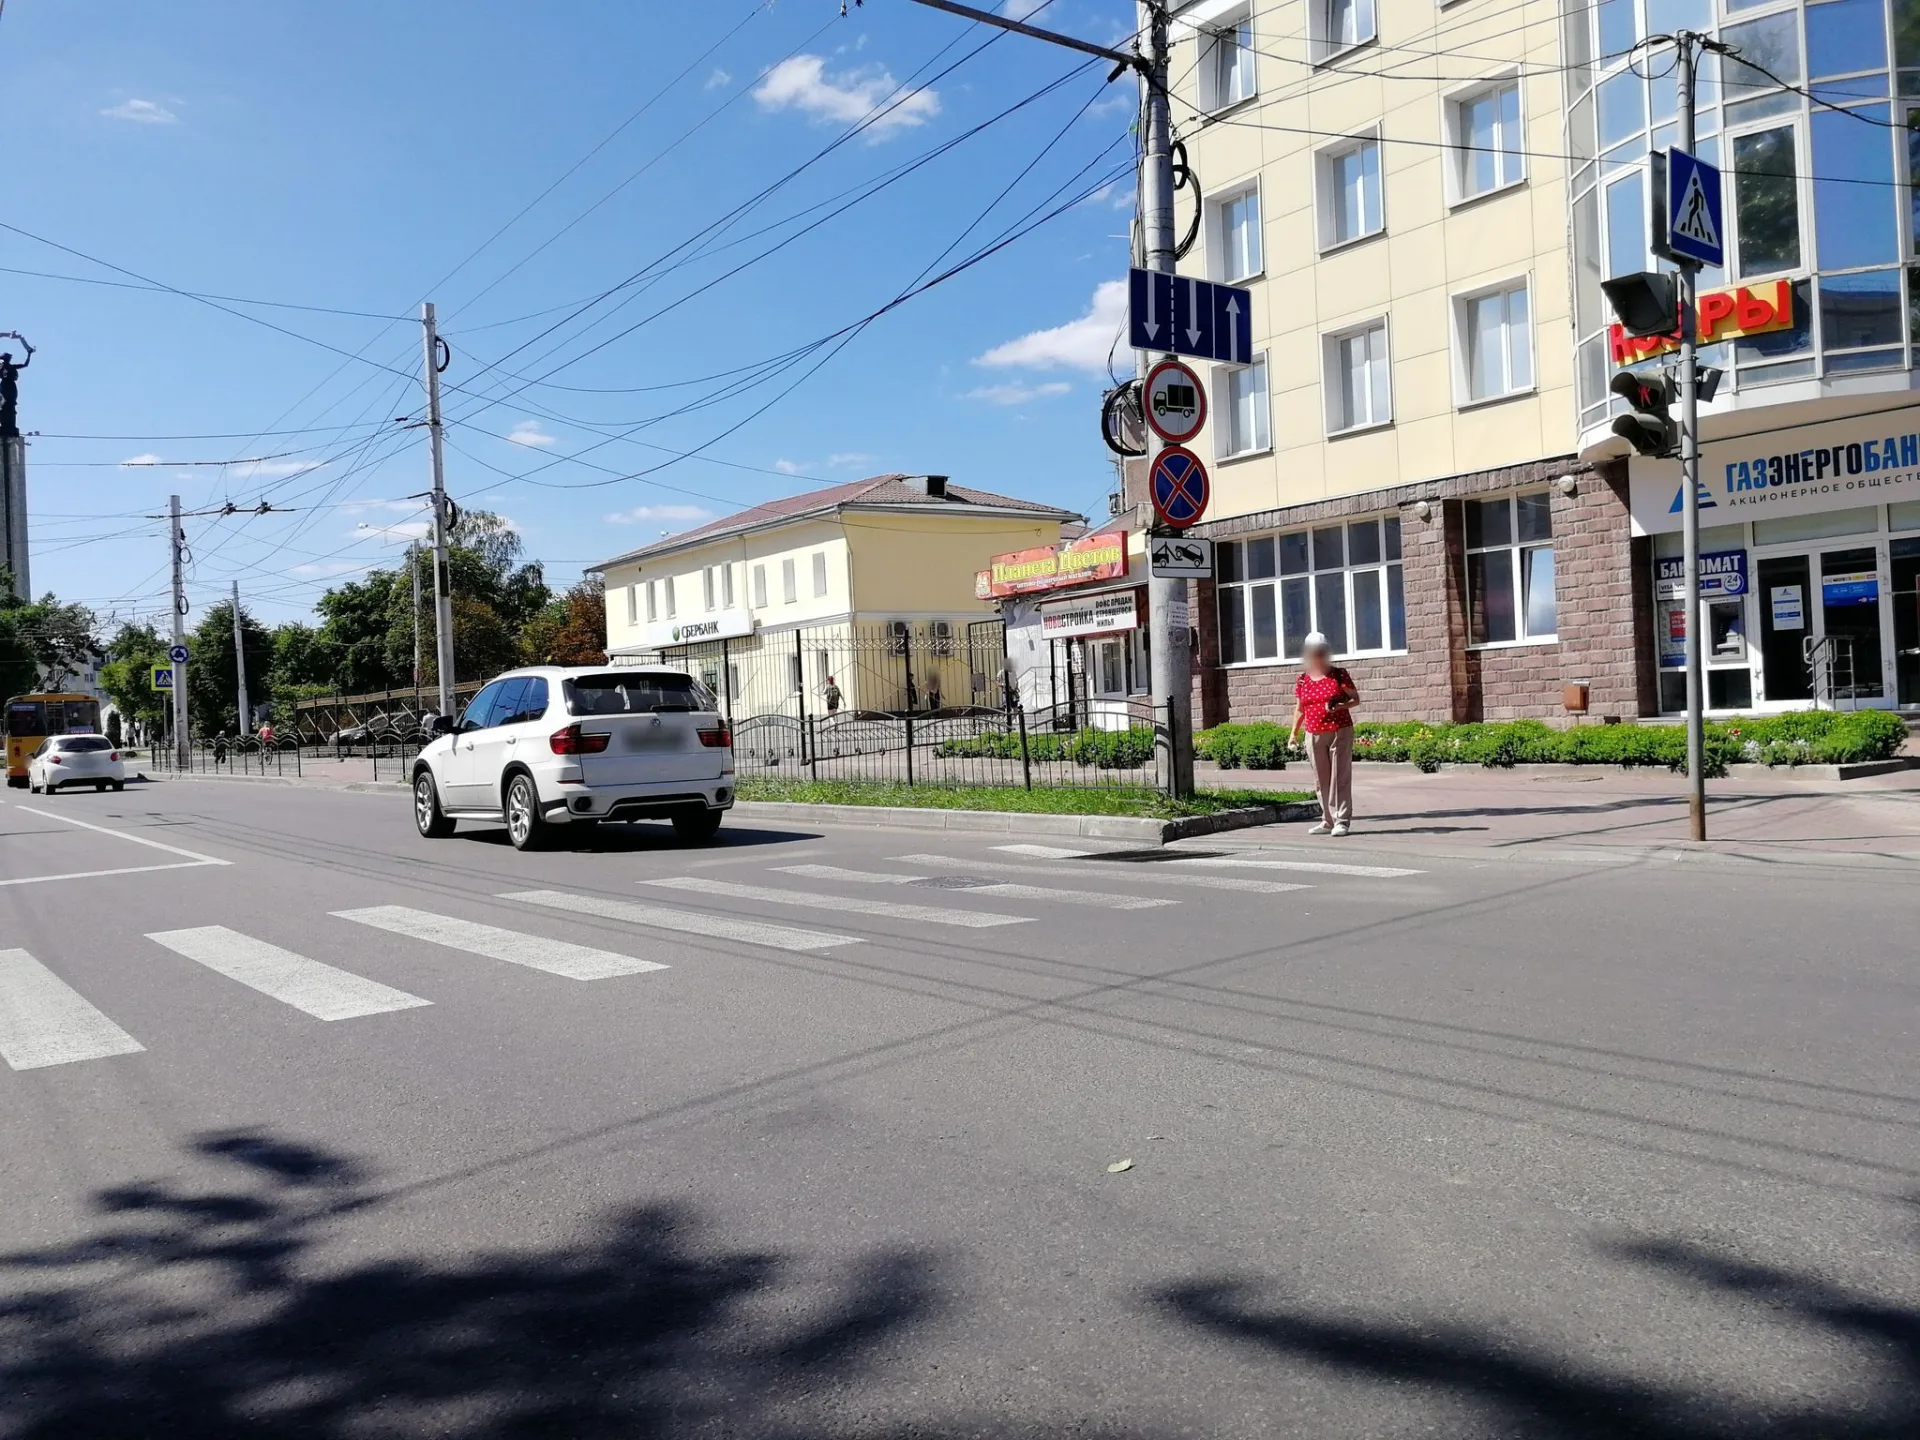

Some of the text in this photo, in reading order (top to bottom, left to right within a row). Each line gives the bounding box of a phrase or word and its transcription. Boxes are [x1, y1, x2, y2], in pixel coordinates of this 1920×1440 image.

[1610, 280, 1792, 362] КРЫ
[1726, 433, 1920, 493] ГАЗЭНЕРГОБАН
[1729, 483, 1840, 506] АКЦИОНЕРНОЕ
[991, 546, 1121, 584] Планета Цветов
[1660, 555, 1740, 578] БАНОМАТ
[1727, 574, 1738, 583] 24
[681, 621, 719, 638] СБЕРБАНК
[1043, 607, 1094, 630] НОВОСТРОЙКА
